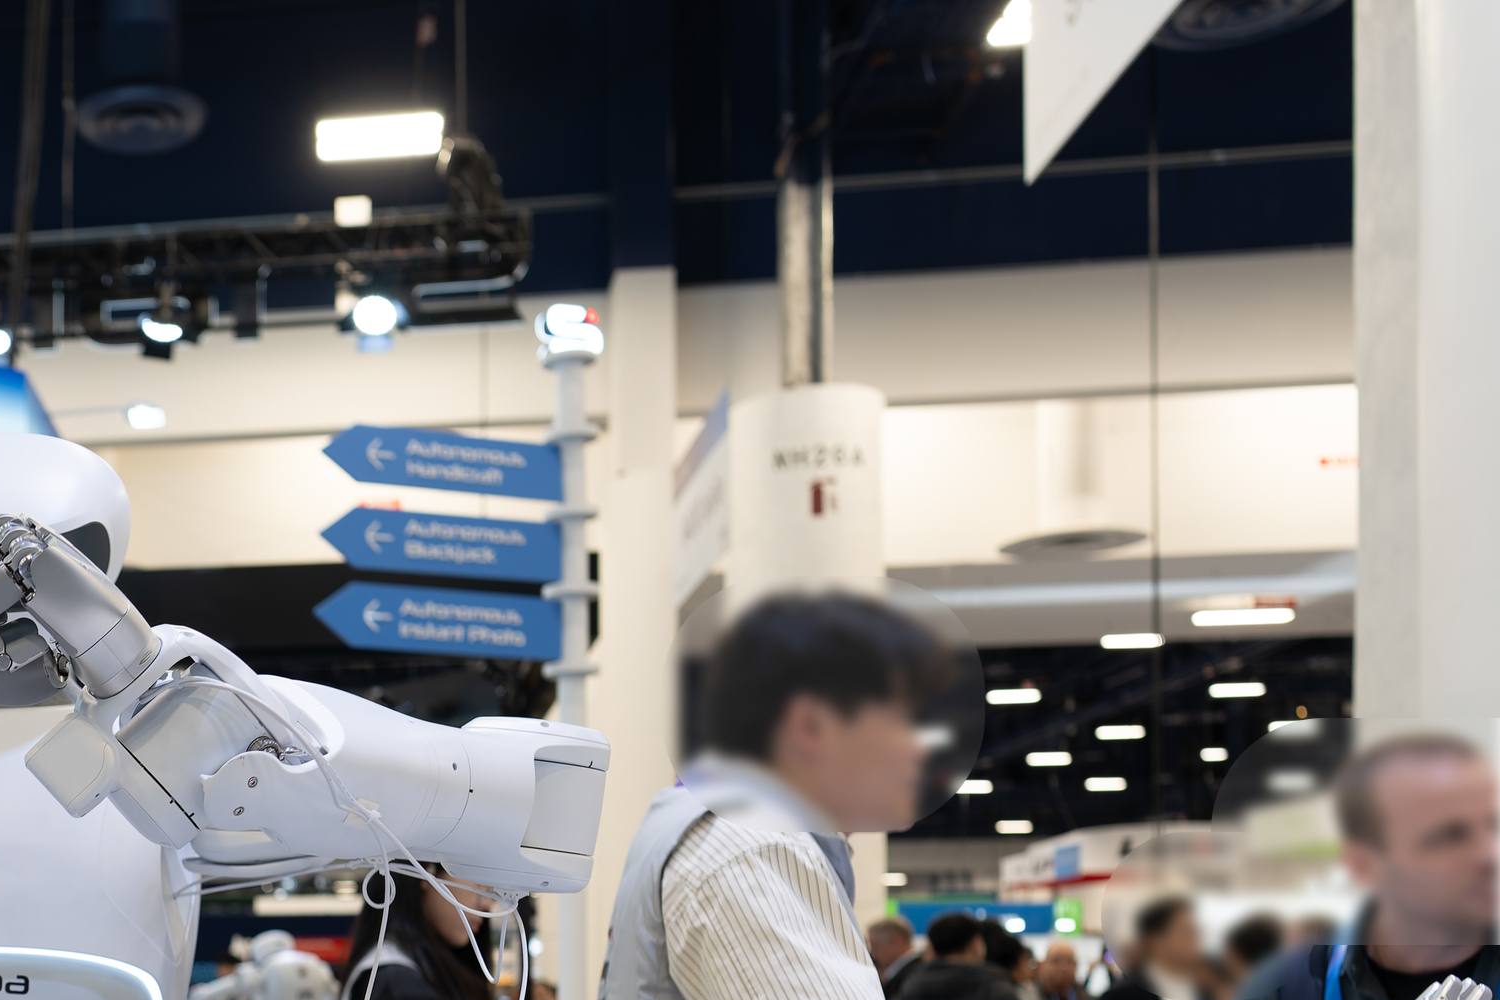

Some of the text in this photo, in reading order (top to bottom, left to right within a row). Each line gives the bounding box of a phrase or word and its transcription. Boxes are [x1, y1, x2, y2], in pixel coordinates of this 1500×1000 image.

[405, 438, 527, 468] Autonomous
[404, 519, 527, 546] Autonomous
[399, 599, 523, 626] Autonomous
